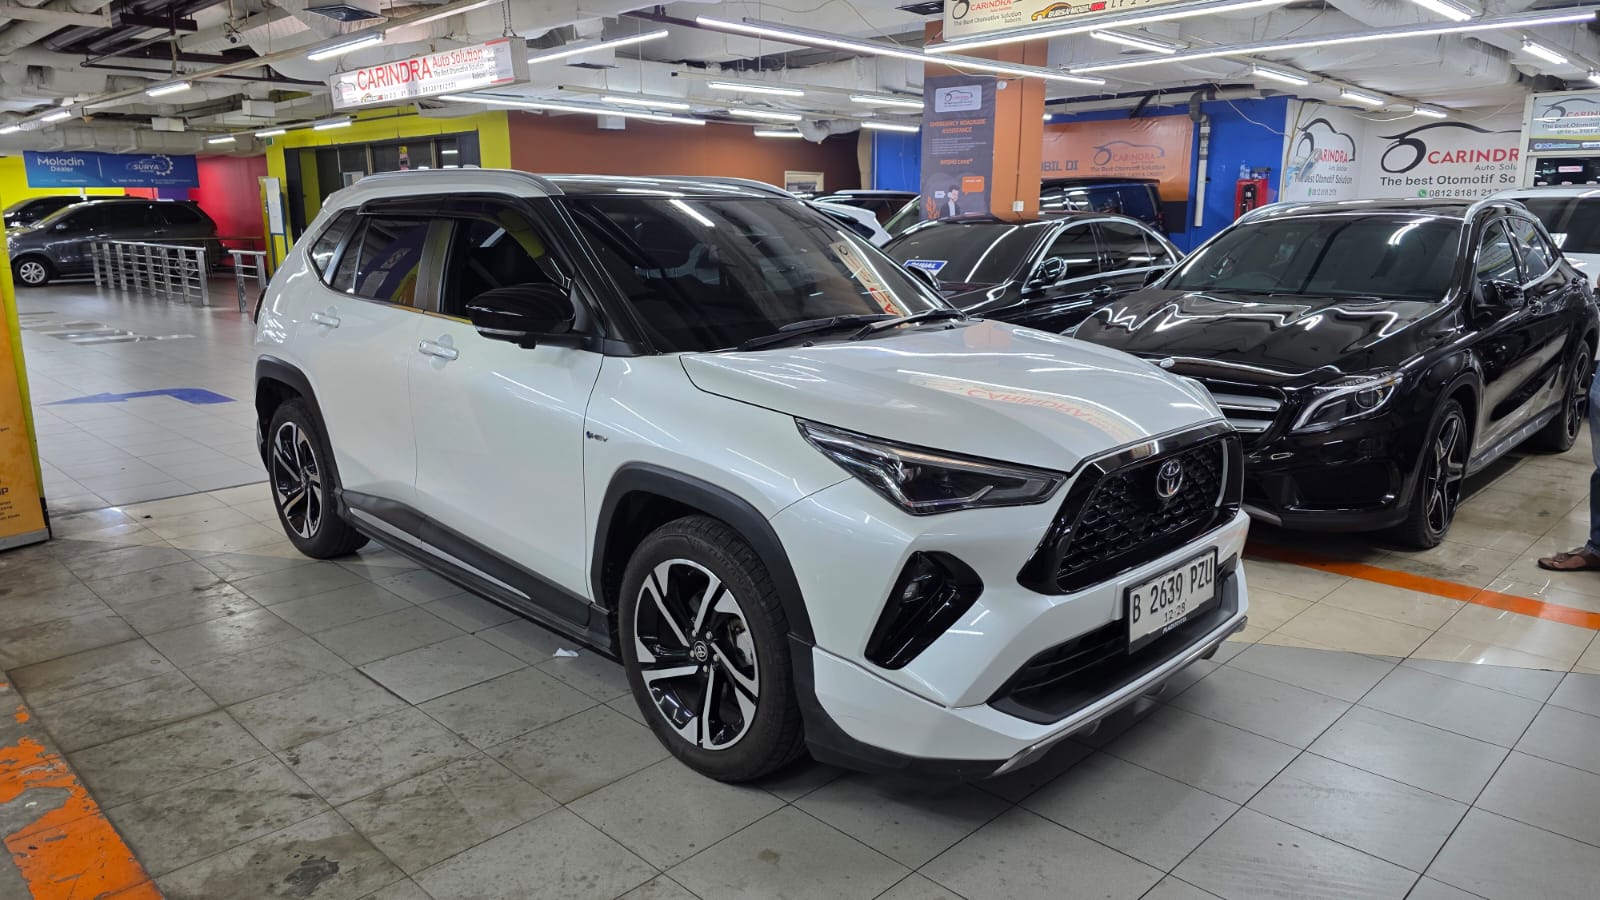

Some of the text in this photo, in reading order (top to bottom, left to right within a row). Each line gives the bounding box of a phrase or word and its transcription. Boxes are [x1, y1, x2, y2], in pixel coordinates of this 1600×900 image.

[356, 57, 433, 92] CARINDRA
[432, 56, 450, 68] Auto
[450, 48, 483, 65] Solution
[36, 156, 85, 167] Moladin
[133, 163, 161, 171] SURYA
[1065, 159, 1079, 171] DI
[1474, 164, 1496, 172] Auto
[1380, 176, 1402, 187] The
[1405, 175, 1433, 186] best
[1436, 173, 1494, 185] Otomotif
[1429, 189, 1452, 198] 0812
[1454, 189, 1478, 197] 8181
[1132, 557, 1213, 624] B 2639 PZU
